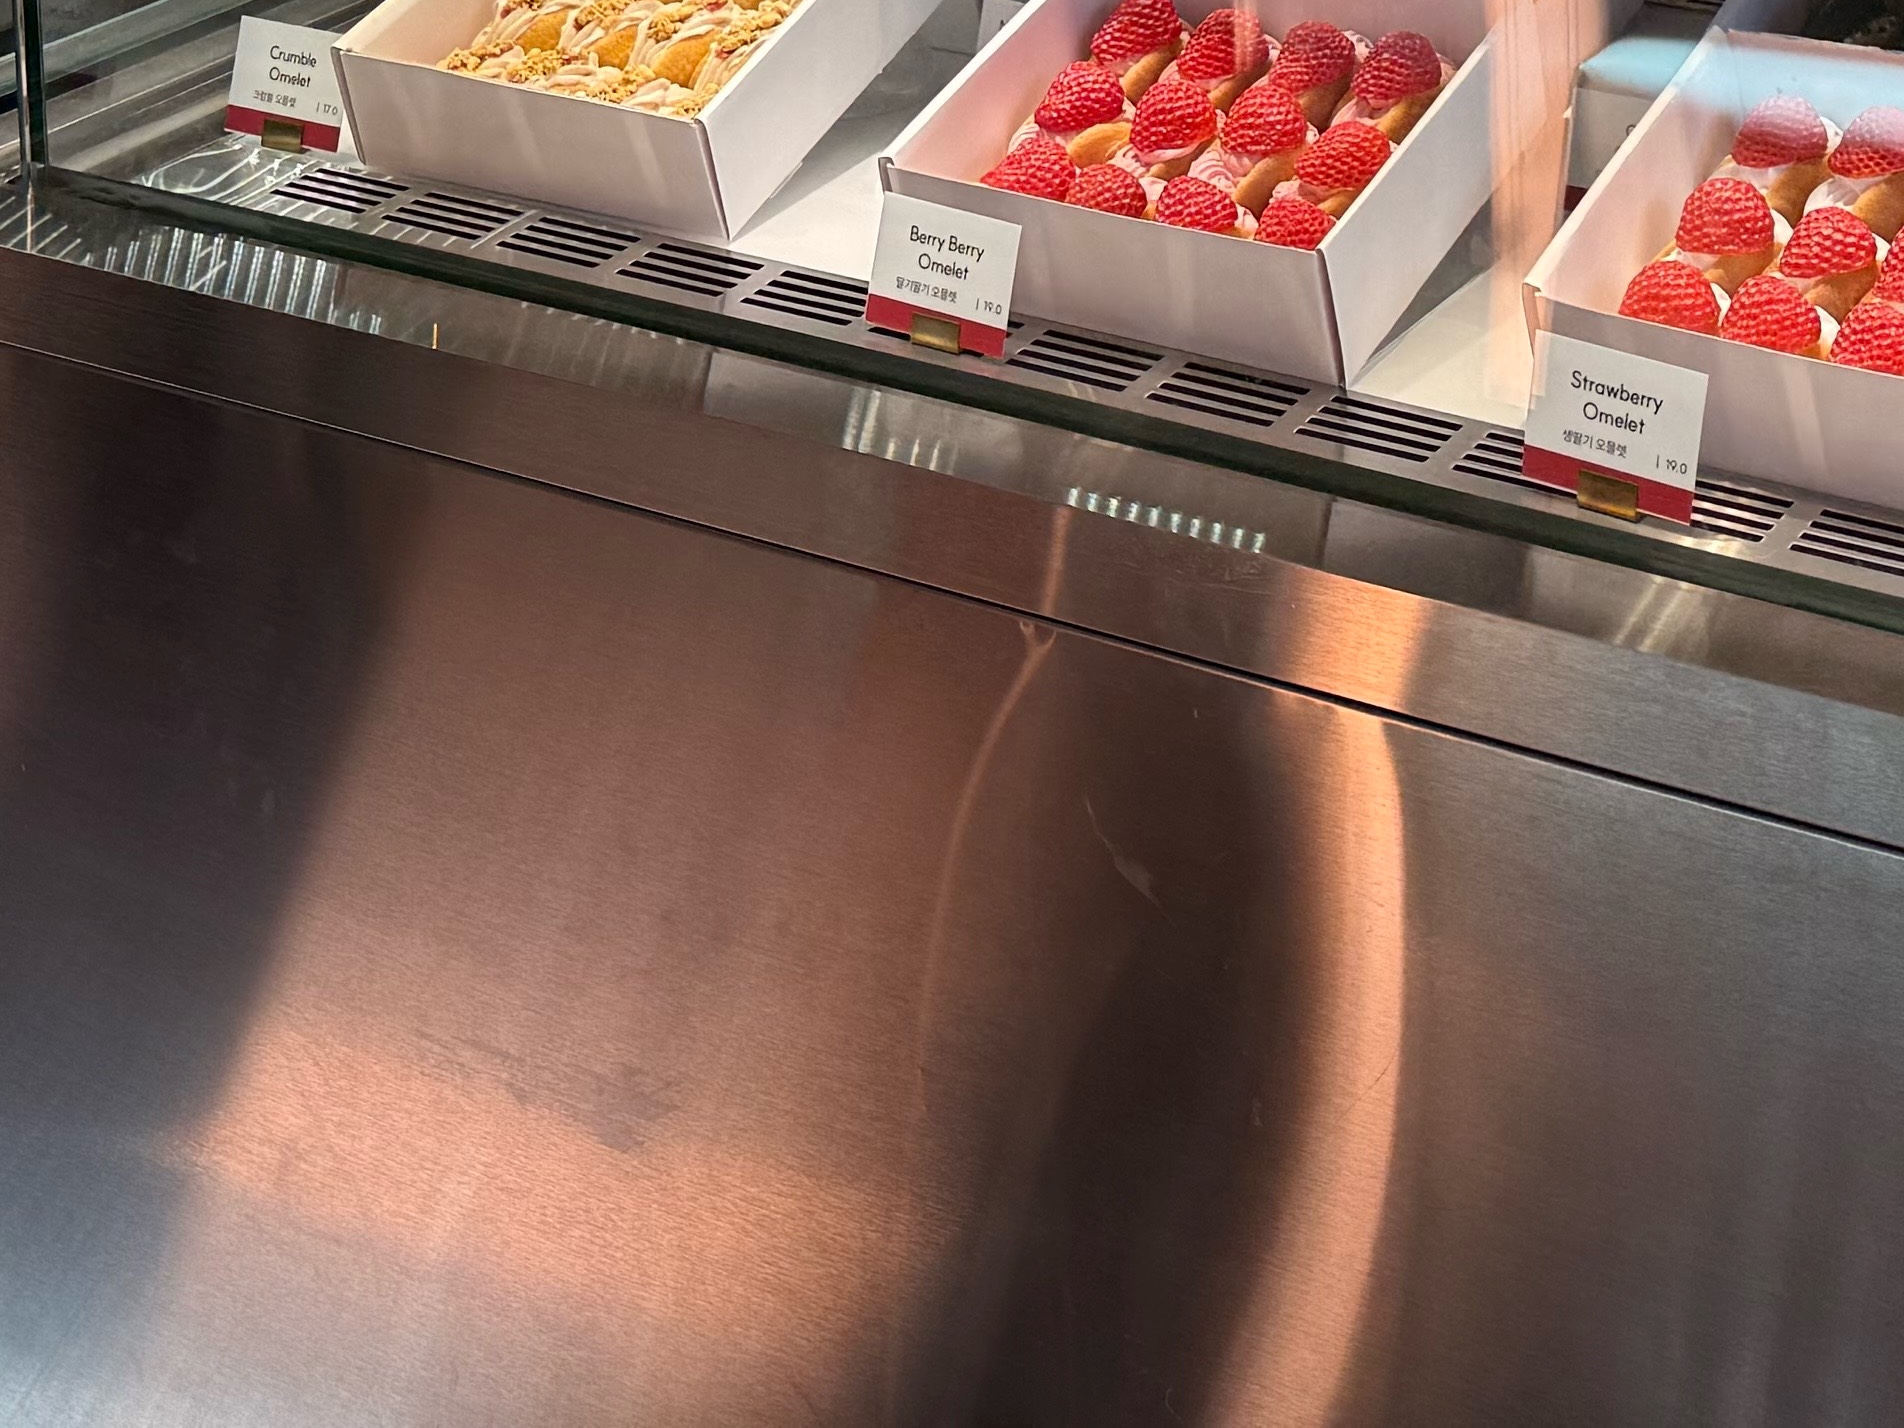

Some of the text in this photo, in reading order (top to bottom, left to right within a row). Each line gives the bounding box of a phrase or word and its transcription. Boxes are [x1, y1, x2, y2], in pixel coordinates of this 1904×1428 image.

[270, 45, 317, 69] Crumble
[269, 67, 310, 89] Omelet
[910, 224, 985, 261] Berry Berry
[919, 255, 969, 284] Omelet
[1571, 370, 1663, 415] Strawberry
[1583, 402, 1645, 434] Omelet
